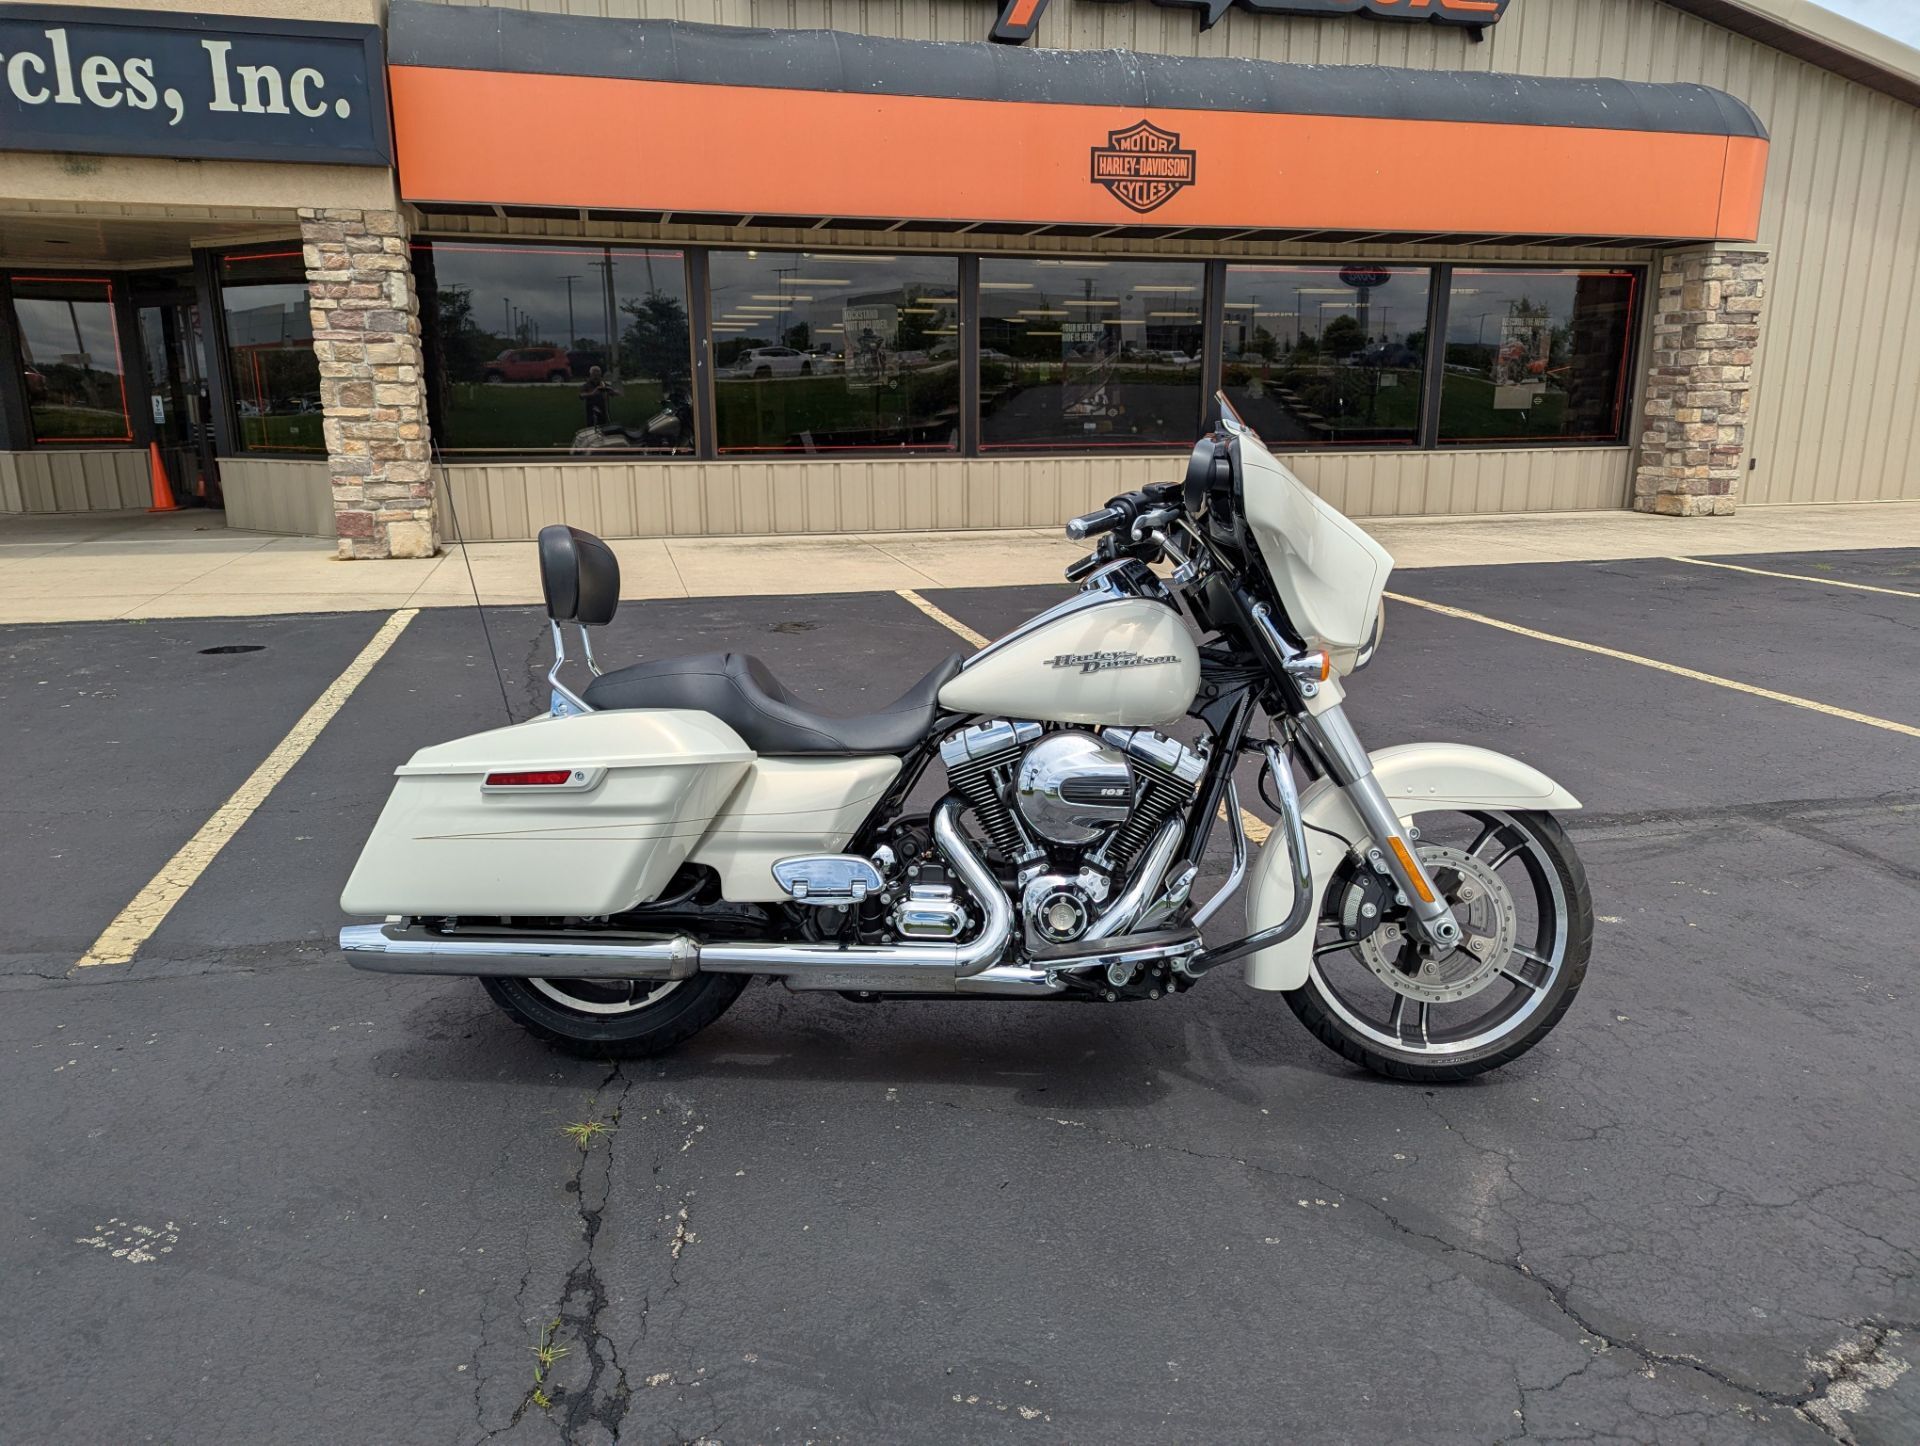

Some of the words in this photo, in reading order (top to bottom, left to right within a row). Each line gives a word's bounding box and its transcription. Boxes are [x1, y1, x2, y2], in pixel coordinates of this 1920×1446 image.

[0, 28, 184, 125] cles,
[201, 39, 351, 119] Inc.
[1121, 131, 1168, 151] MOTOR
[1099, 156, 1187, 177] HARLEY-DAVIDSON
[1120, 181, 1166, 204] CYCLES
[1043, 650, 1137, 669] Harley
[1080, 654, 1181, 675] Davidson
[1101, 788, 1125, 796] 103
